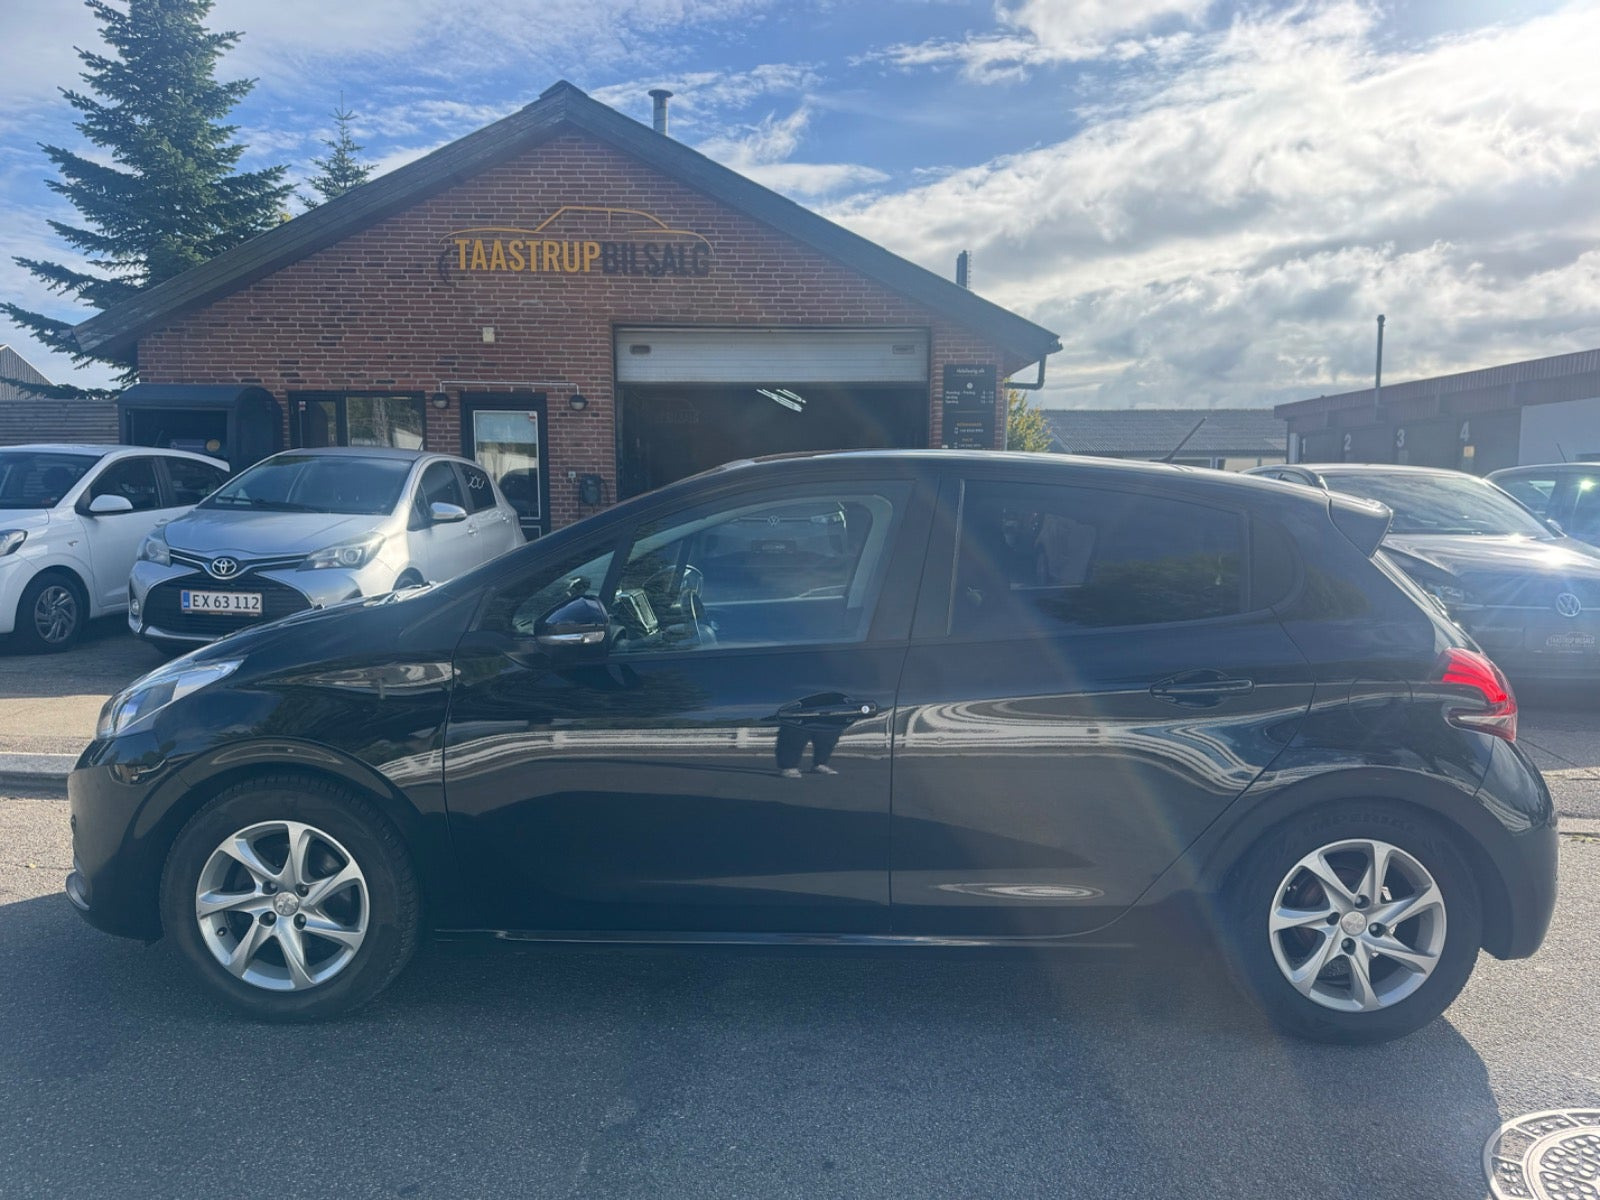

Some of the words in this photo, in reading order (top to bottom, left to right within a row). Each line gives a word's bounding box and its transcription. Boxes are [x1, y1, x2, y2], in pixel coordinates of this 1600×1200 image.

[1396, 429, 1405, 448] 3
[1460, 421, 1470, 442] 4
[1344, 433, 1352, 451] 2
[193, 594, 210, 608] EX
[213, 596, 230, 609] 63
[234, 596, 260, 610] 112
